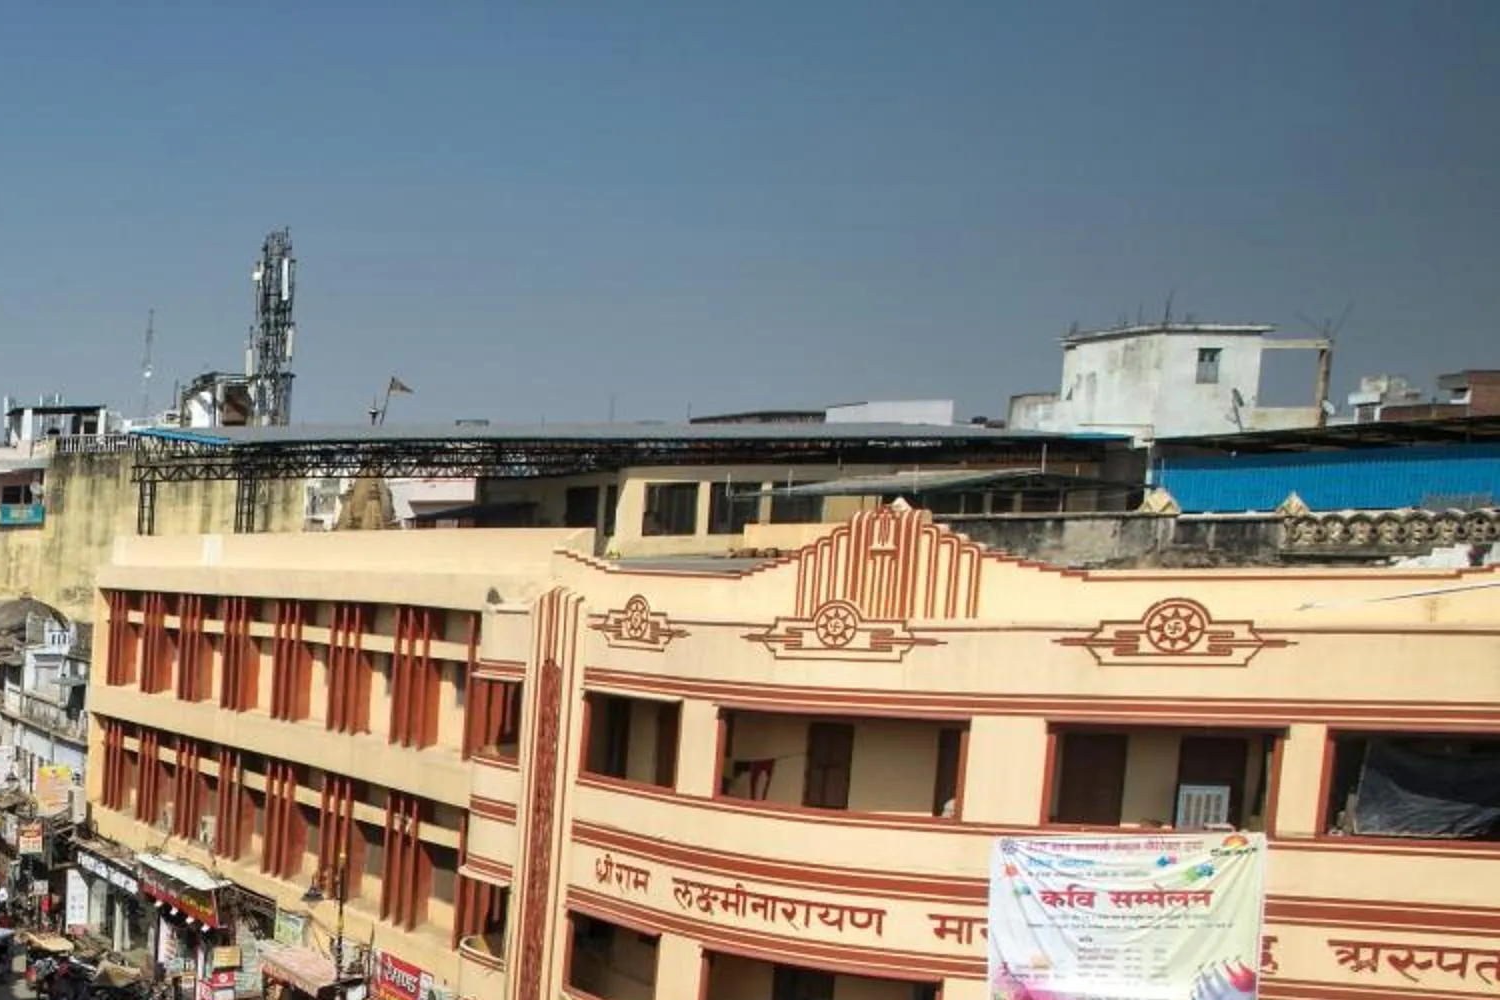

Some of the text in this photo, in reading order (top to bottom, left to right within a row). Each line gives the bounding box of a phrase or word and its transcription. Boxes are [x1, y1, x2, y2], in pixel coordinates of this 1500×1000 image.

[595, 853, 651, 895] श्रीराम
[672, 877, 887, 936] लक्ष्मीनारायण
[1327, 939, 1500, 985] अस्पत
[1040, 882, 1214, 909] कवि सम्मेलन
